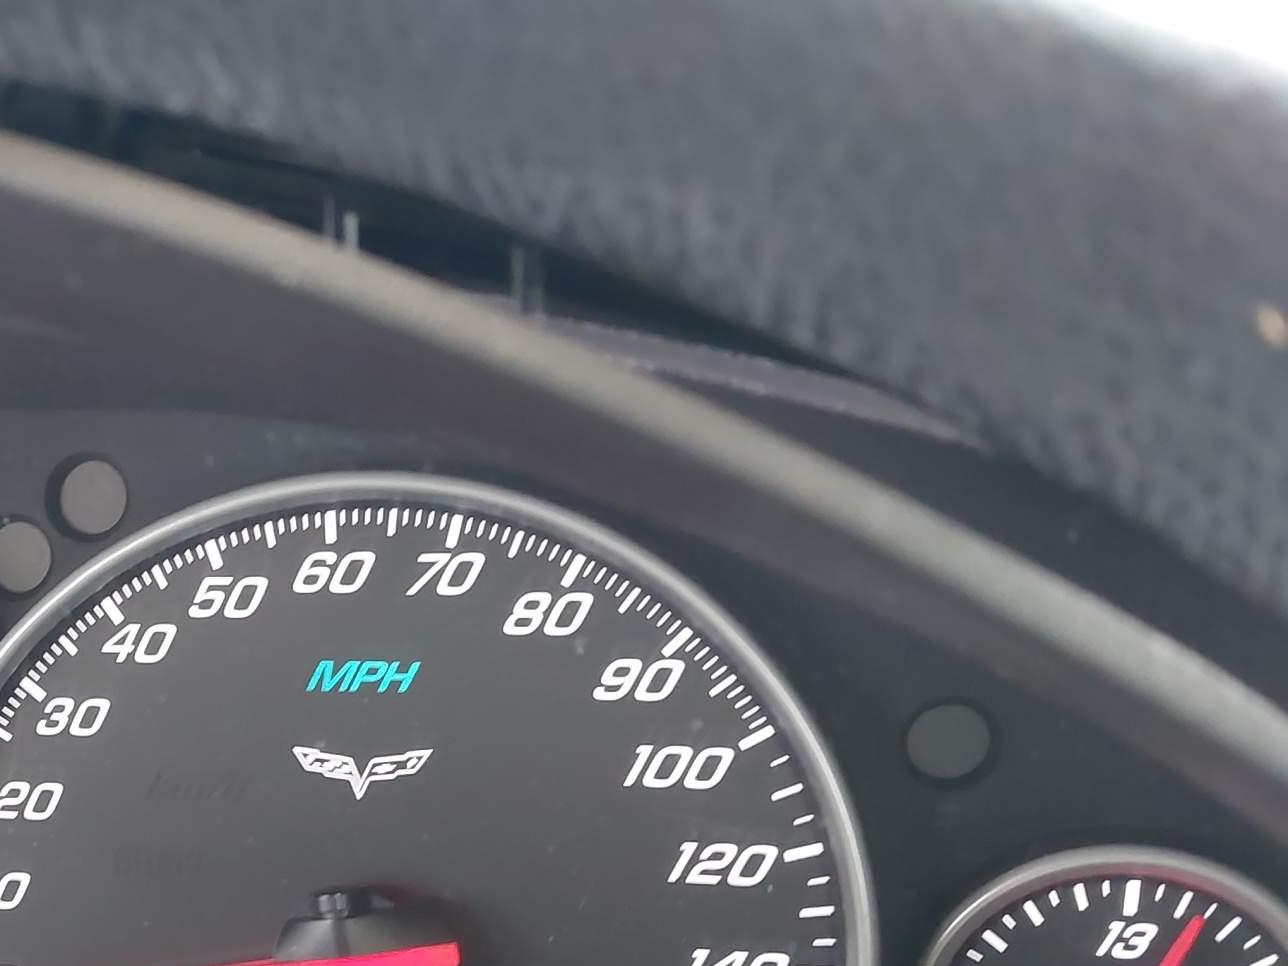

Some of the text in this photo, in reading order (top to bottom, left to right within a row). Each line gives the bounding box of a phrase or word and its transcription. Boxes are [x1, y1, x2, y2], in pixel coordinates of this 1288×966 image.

[292, 550, 376, 594] 60
[405, 551, 486, 596] 70
[188, 576, 269, 619] 50
[502, 591, 595, 637] 80
[100, 622, 178, 664] 40
[305, 658, 421, 694] MPH
[592, 658, 686, 702] 90
[35, 697, 111, 737] 30
[622, 744, 735, 790] 100
[667, 841, 779, 887] 120
[1095, 920, 1159, 960] 13
